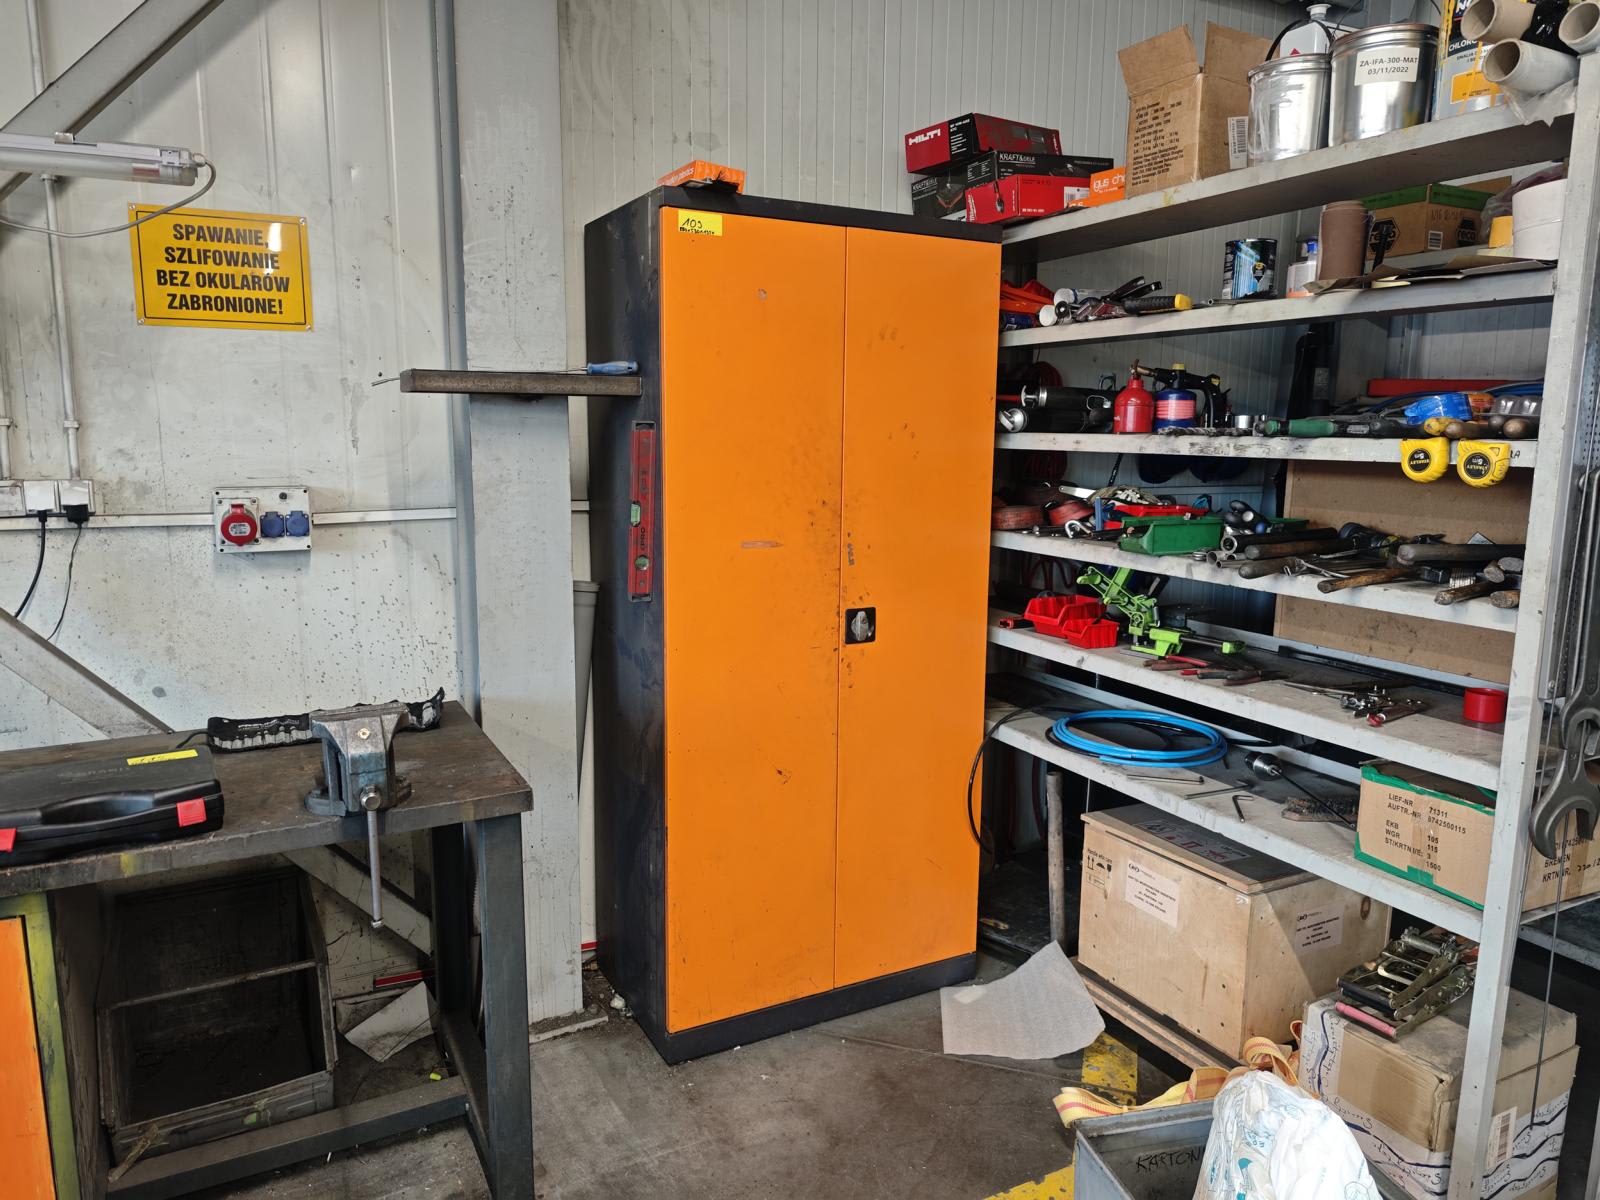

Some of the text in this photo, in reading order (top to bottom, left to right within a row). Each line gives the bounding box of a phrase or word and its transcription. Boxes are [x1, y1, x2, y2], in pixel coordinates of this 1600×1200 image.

[1367, 66, 1409, 76] 03/11/2022
[908, 128, 941, 146] HILTI
[172, 223, 269, 249] SPAWANIE,
[164, 246, 280, 270] SZLIFOWANIE
[156, 269, 290, 293] BEZ OKULARÓW
[166, 293, 284, 315] ZABRONIONE!
[1388, 792, 1448, 818] LIEF-NR 71311
[1385, 828, 1400, 840] WGR
[1386, 819, 1399, 830] EKB
